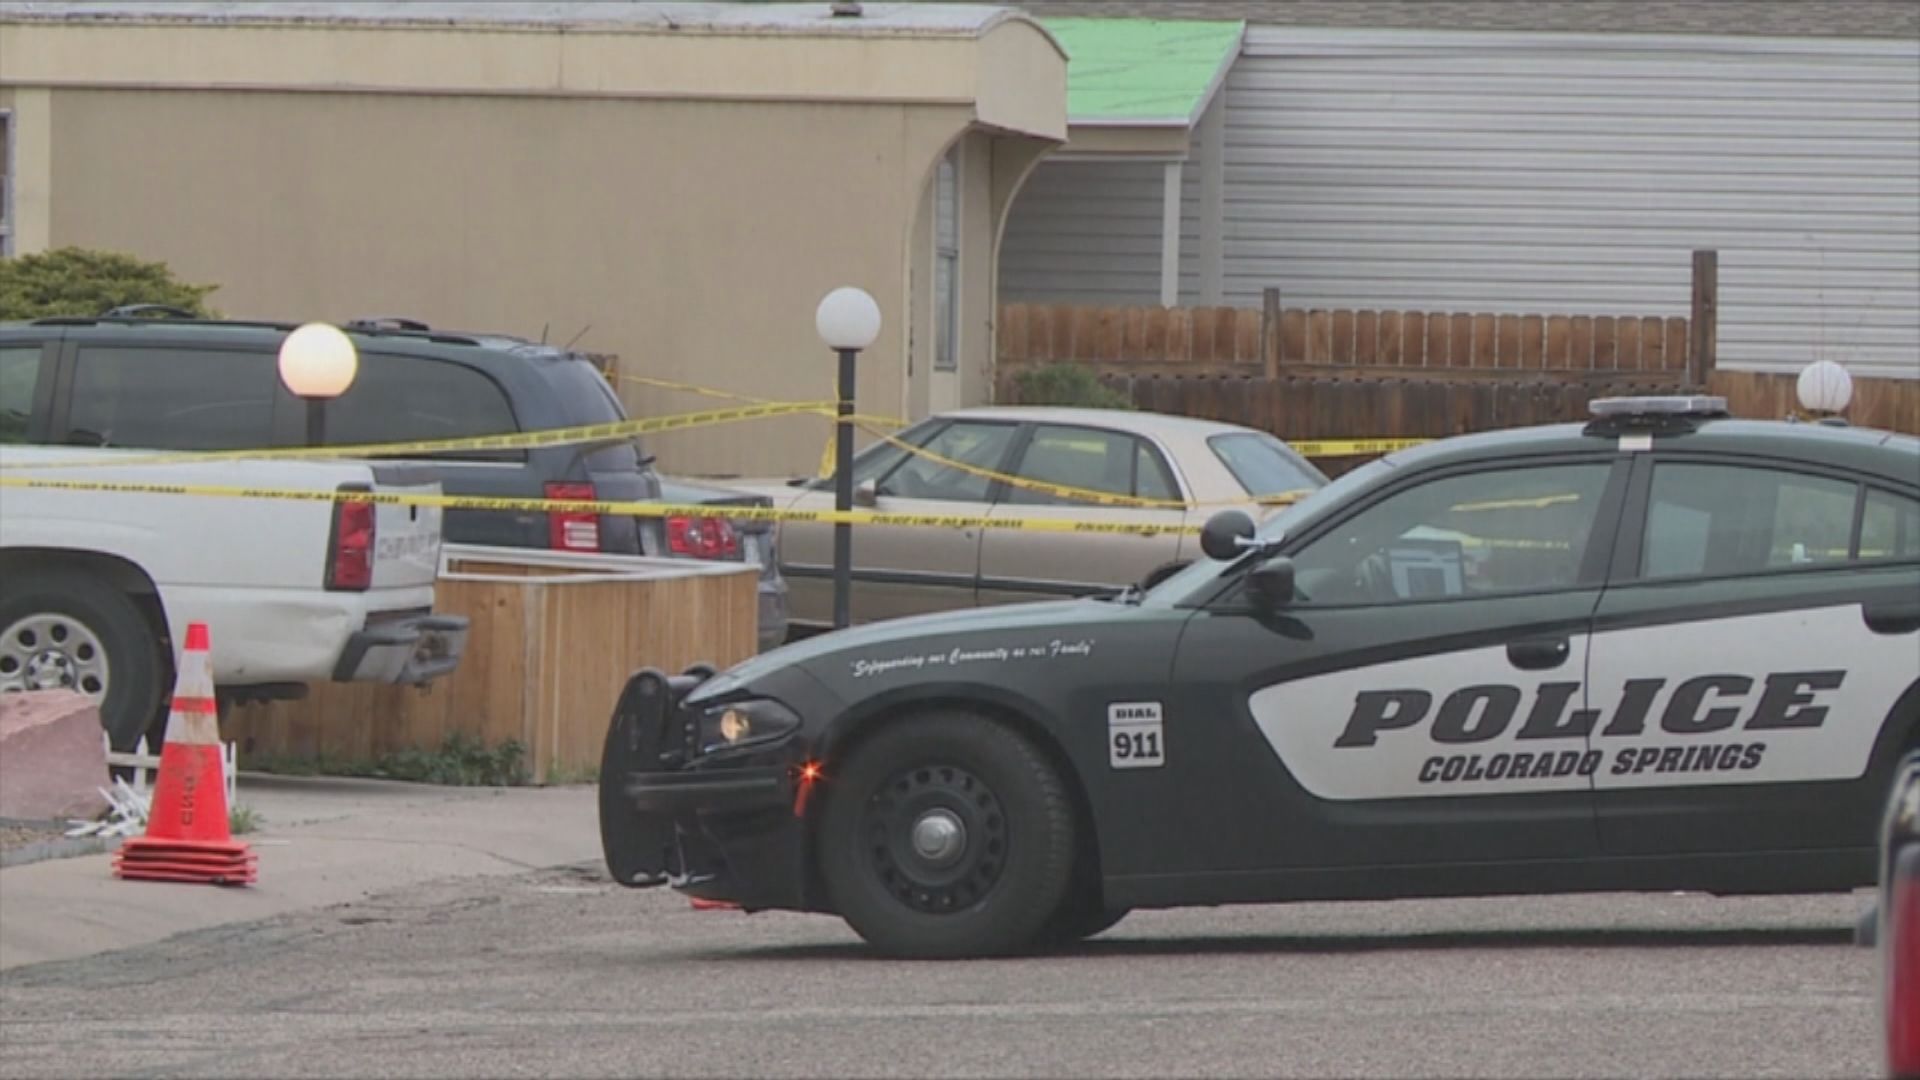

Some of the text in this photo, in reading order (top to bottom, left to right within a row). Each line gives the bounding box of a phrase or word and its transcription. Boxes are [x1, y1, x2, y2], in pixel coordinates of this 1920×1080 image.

[1116, 708, 1157, 719] DIAL
[1333, 670, 1847, 748] POLICE
[1114, 732, 1160, 759] 911
[1418, 742, 1767, 784] COLORADO SPRINGS
